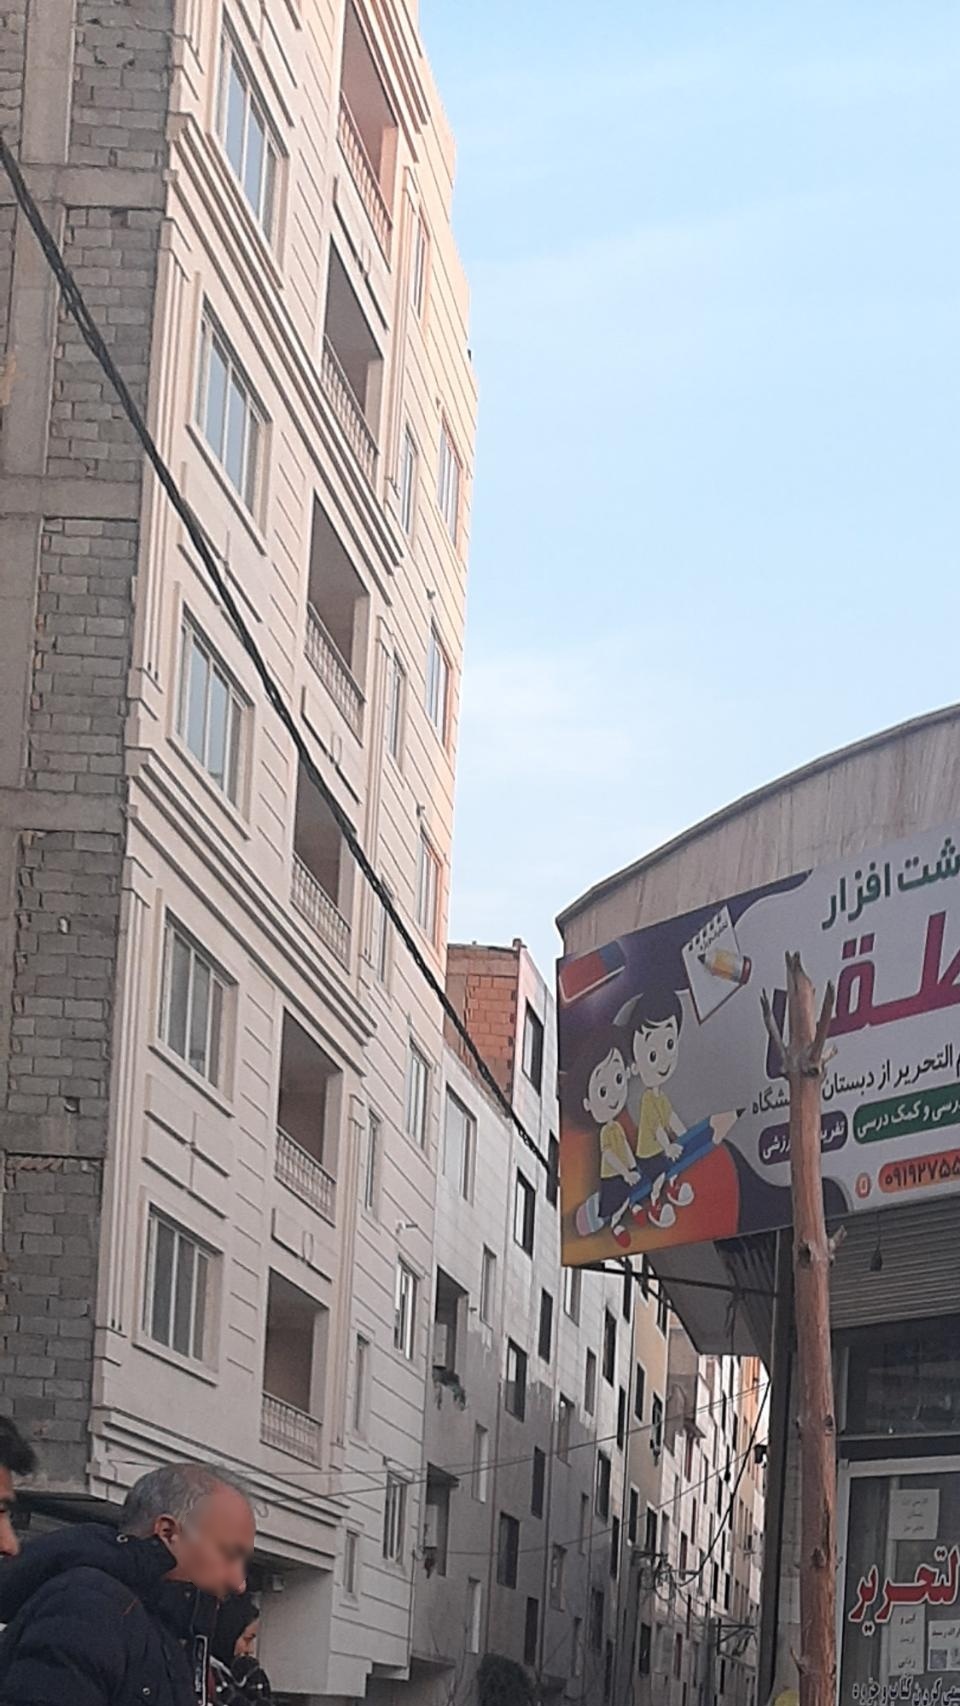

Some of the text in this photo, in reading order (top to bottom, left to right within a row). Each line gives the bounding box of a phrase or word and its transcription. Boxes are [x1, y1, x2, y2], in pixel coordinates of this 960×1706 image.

[821, 861, 891, 931] افزار
[878, 1059, 891, 1091] از
[894, 1043, 953, 1088] التحریر
[752, 1086, 790, 1114] شگاه
[822, 1071, 874, 1101] دبستان
[857, 1114, 889, 1138] درسی
[891, 1099, 921, 1124] کمک
[923, 1106, 928, 1121] و
[763, 1121, 845, 1159] تفری رزشی
[881, 1684, 888, 1706] و
